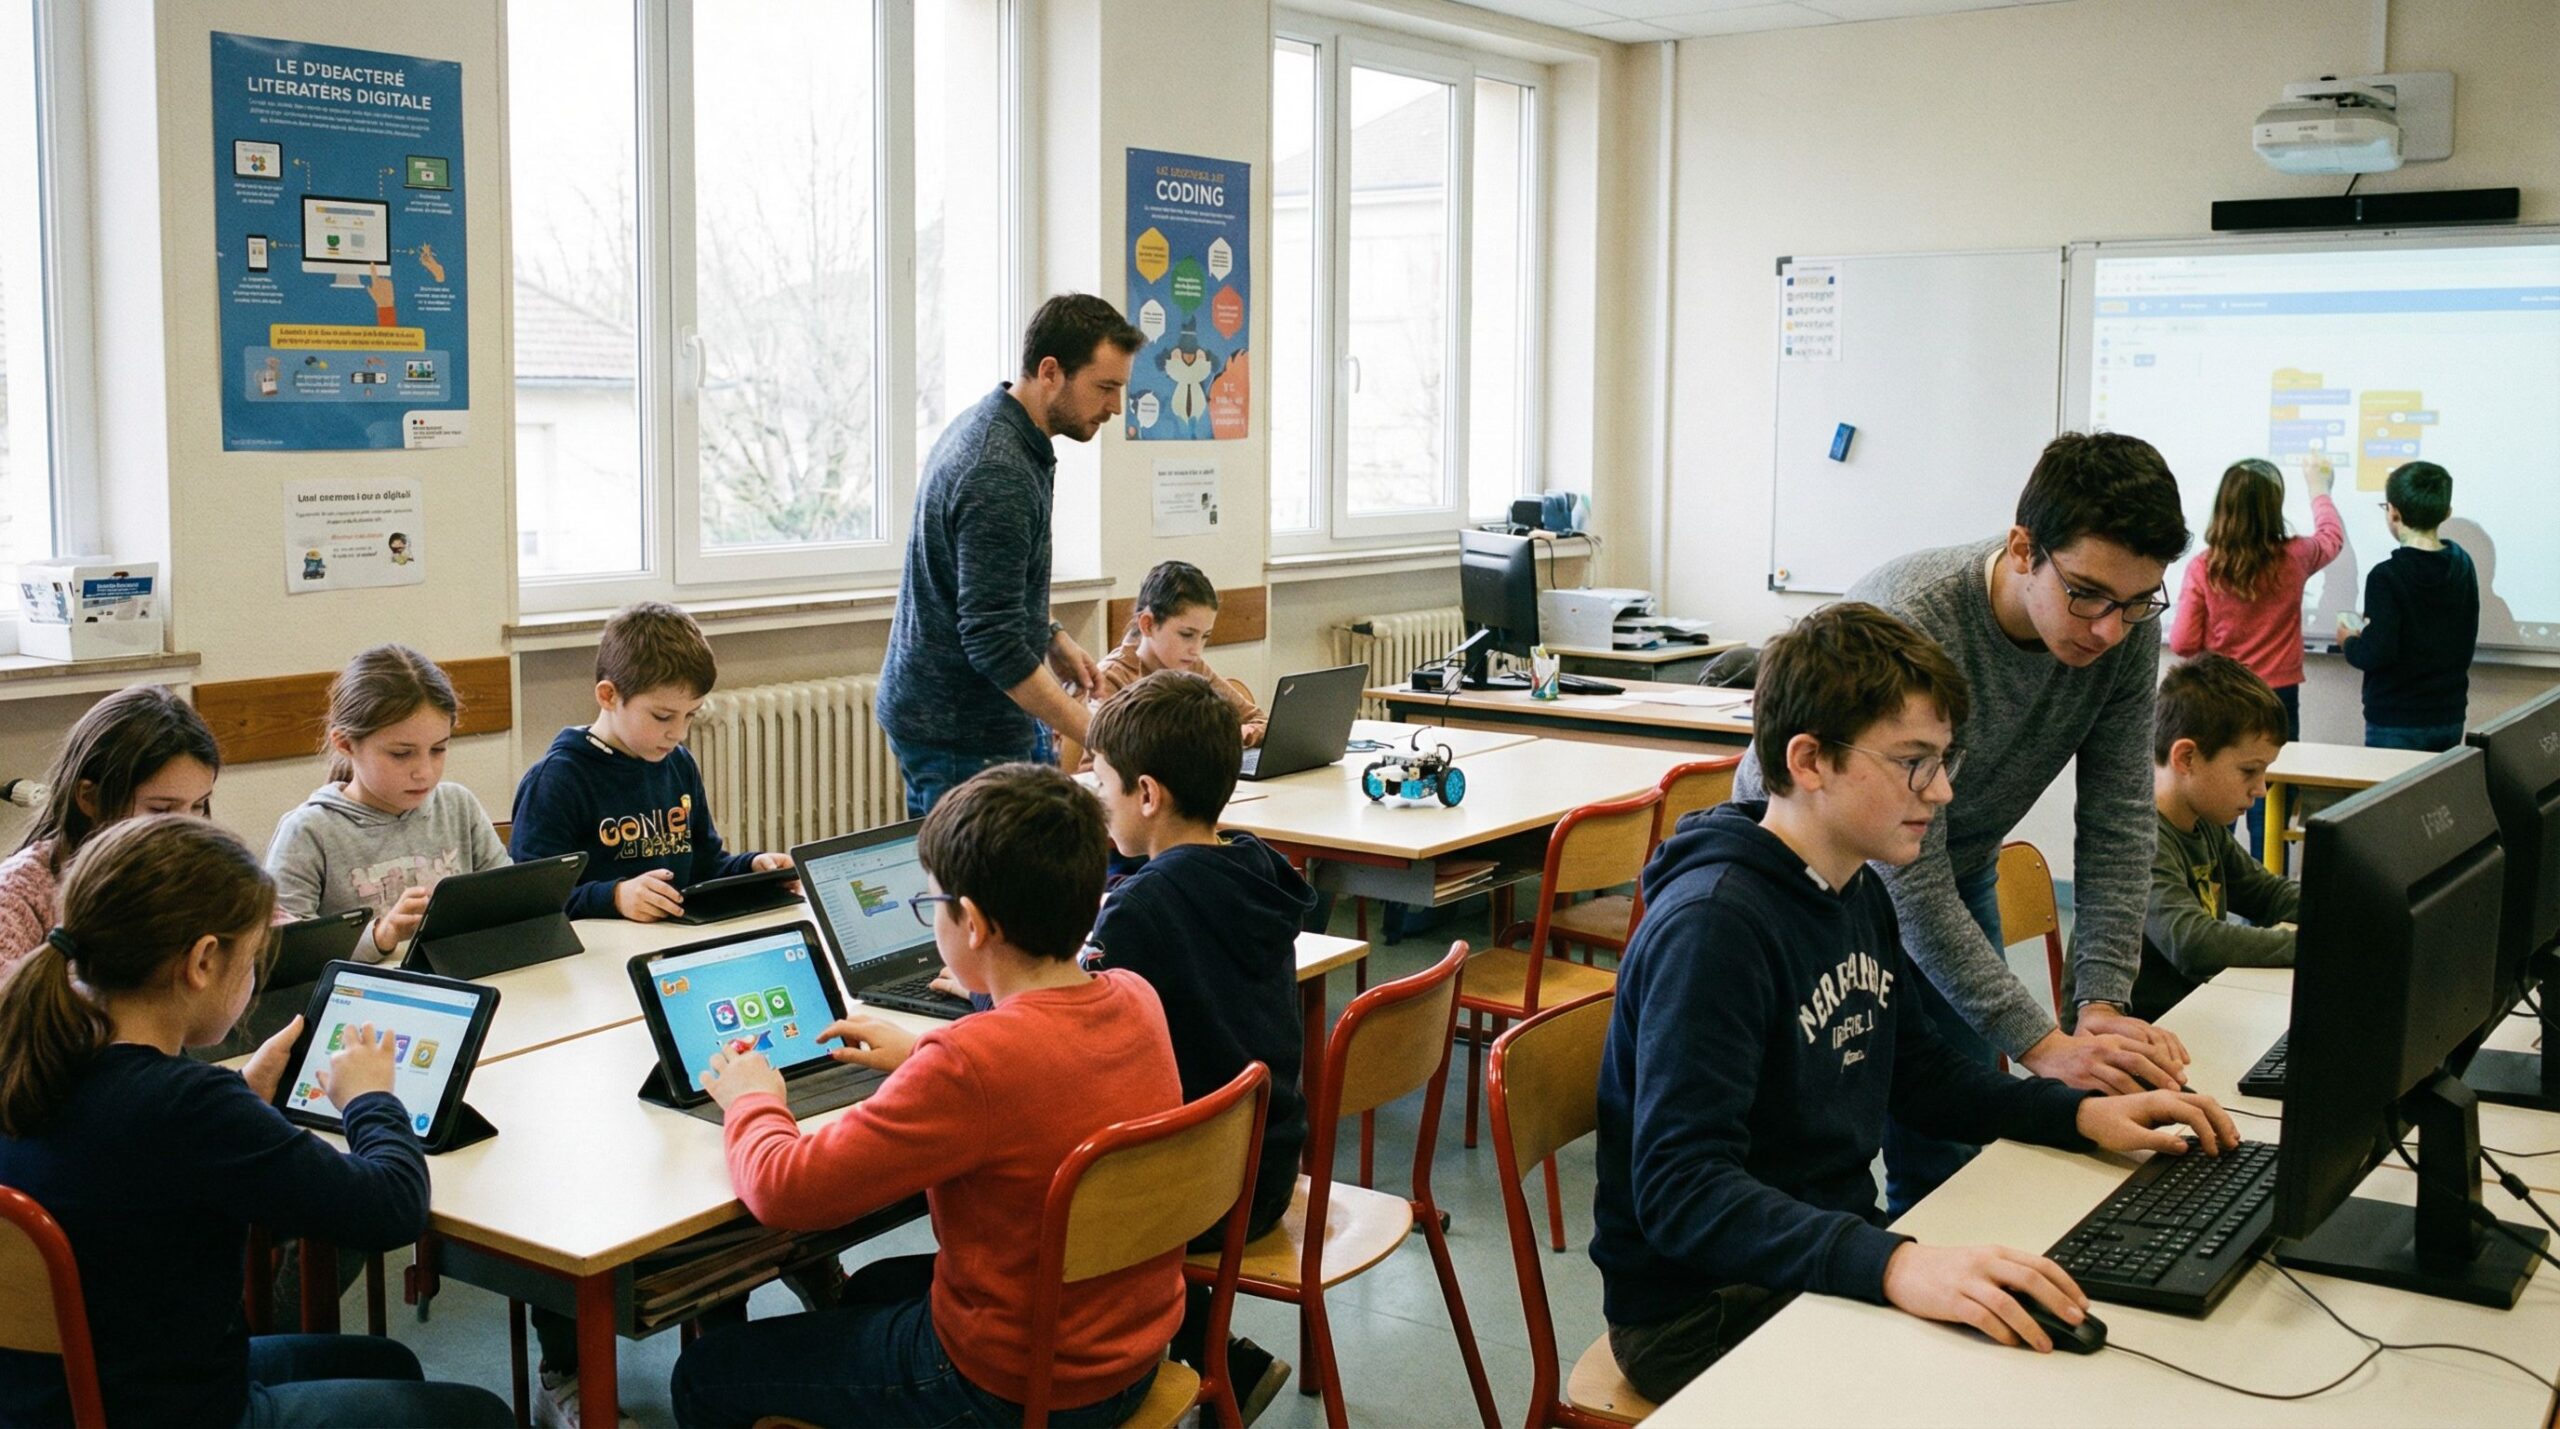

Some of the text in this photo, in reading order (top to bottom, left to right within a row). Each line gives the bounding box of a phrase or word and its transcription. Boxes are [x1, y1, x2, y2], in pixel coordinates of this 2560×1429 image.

[276, 58, 297, 75] LE
[357, 89, 432, 111] DIGITALE
[1156, 179, 1225, 207] CODING
